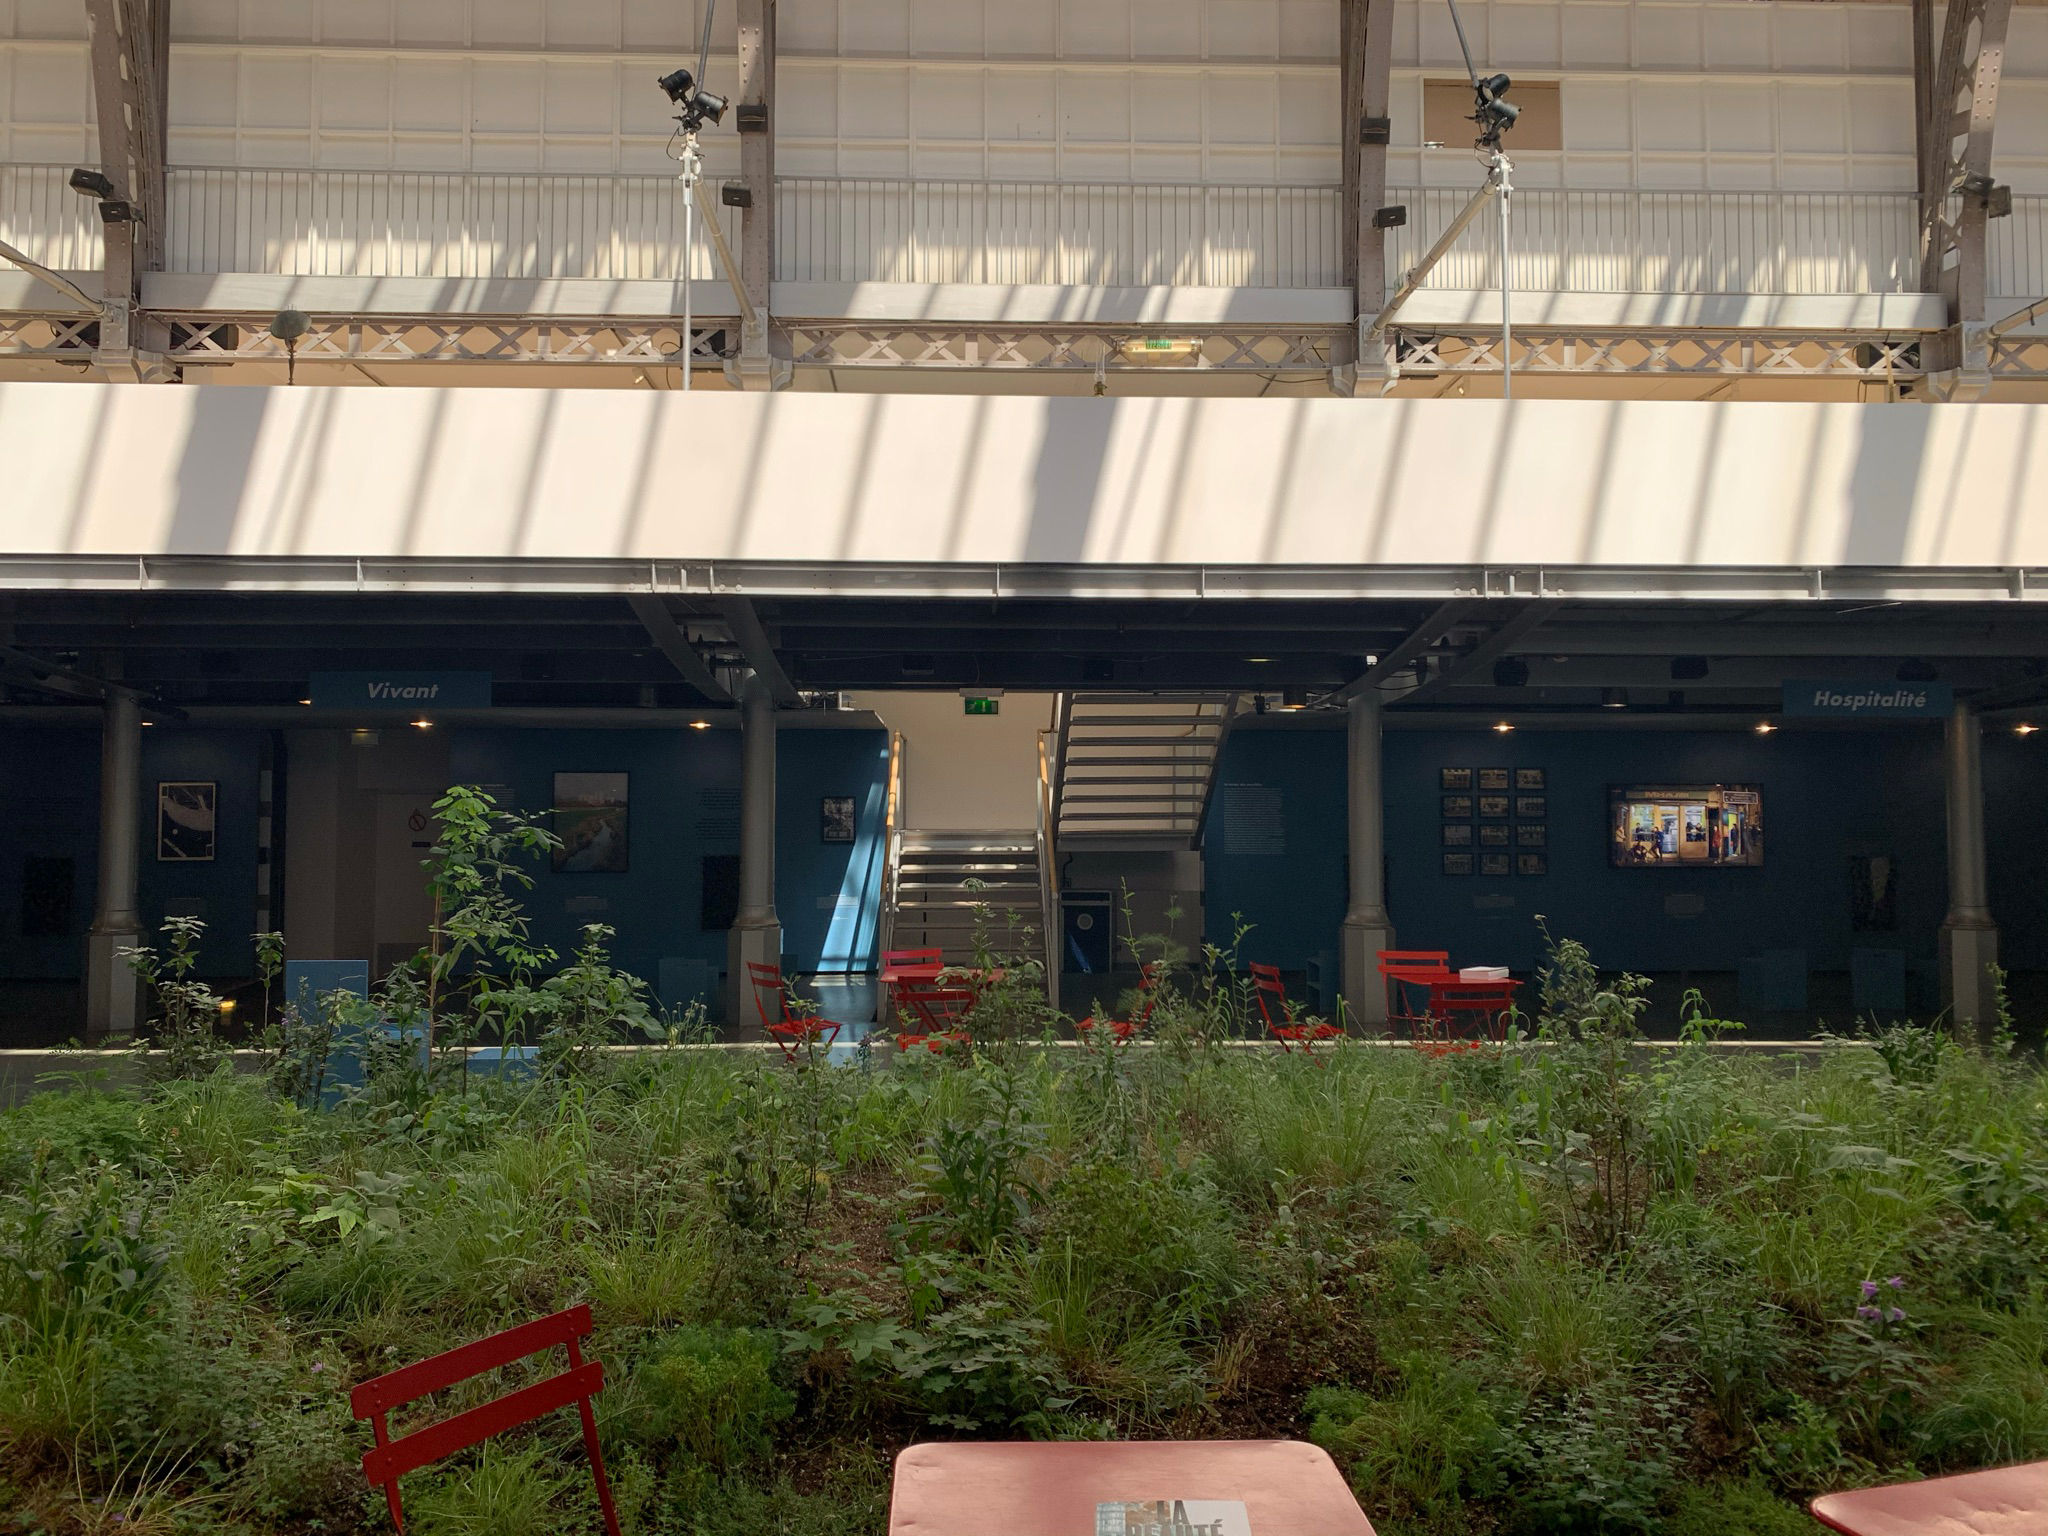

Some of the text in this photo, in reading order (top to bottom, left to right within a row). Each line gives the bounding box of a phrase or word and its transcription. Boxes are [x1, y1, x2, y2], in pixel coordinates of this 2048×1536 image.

[368, 682, 439, 698] Vivant
[1814, 690, 1927, 711] Hospitalité
[1156, 1500, 1190, 1525] LA
